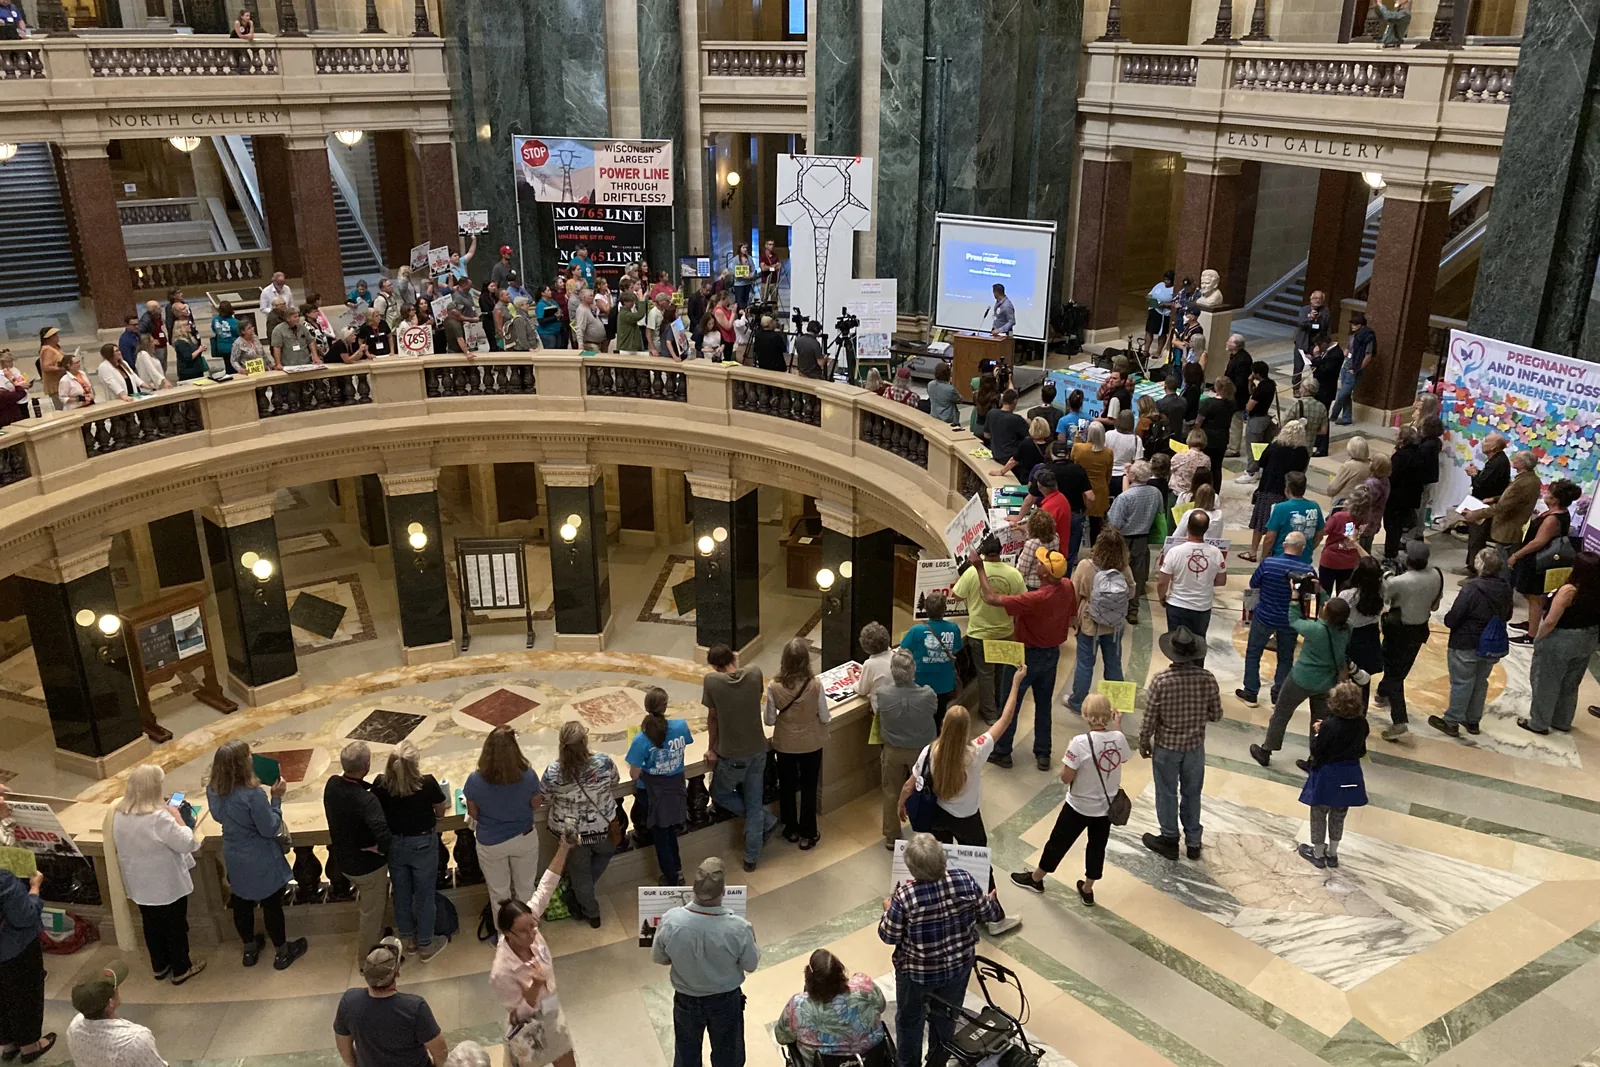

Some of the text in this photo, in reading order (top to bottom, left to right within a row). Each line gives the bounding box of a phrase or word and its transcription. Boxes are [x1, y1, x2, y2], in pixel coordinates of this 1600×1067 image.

[108, 111, 281, 127] NORTH GALLERY
[604, 144, 662, 154] WISCONSIN'S
[1227, 131, 1384, 159] EAST GALLERY
[523, 146, 546, 160] STOP
[613, 155, 654, 164] LARGEST
[599, 167, 669, 180] POWER LINE
[610, 181, 658, 191] THROUGH
[603, 192, 666, 203] DRIFTLESS?
[407, 333, 425, 344] 765
[1507, 350, 1587, 378] PREGNANCY
[1487, 361, 1600, 398] AND INFANT LOSS
[1488, 376, 1598, 412] AWARENESS DAY
[1305, 508, 1318, 520] 200
[941, 632, 955, 644] 200
[667, 735, 686, 752] 200
[30, 804, 49, 812] GAIN
[957, 849, 973, 857] THEIR
